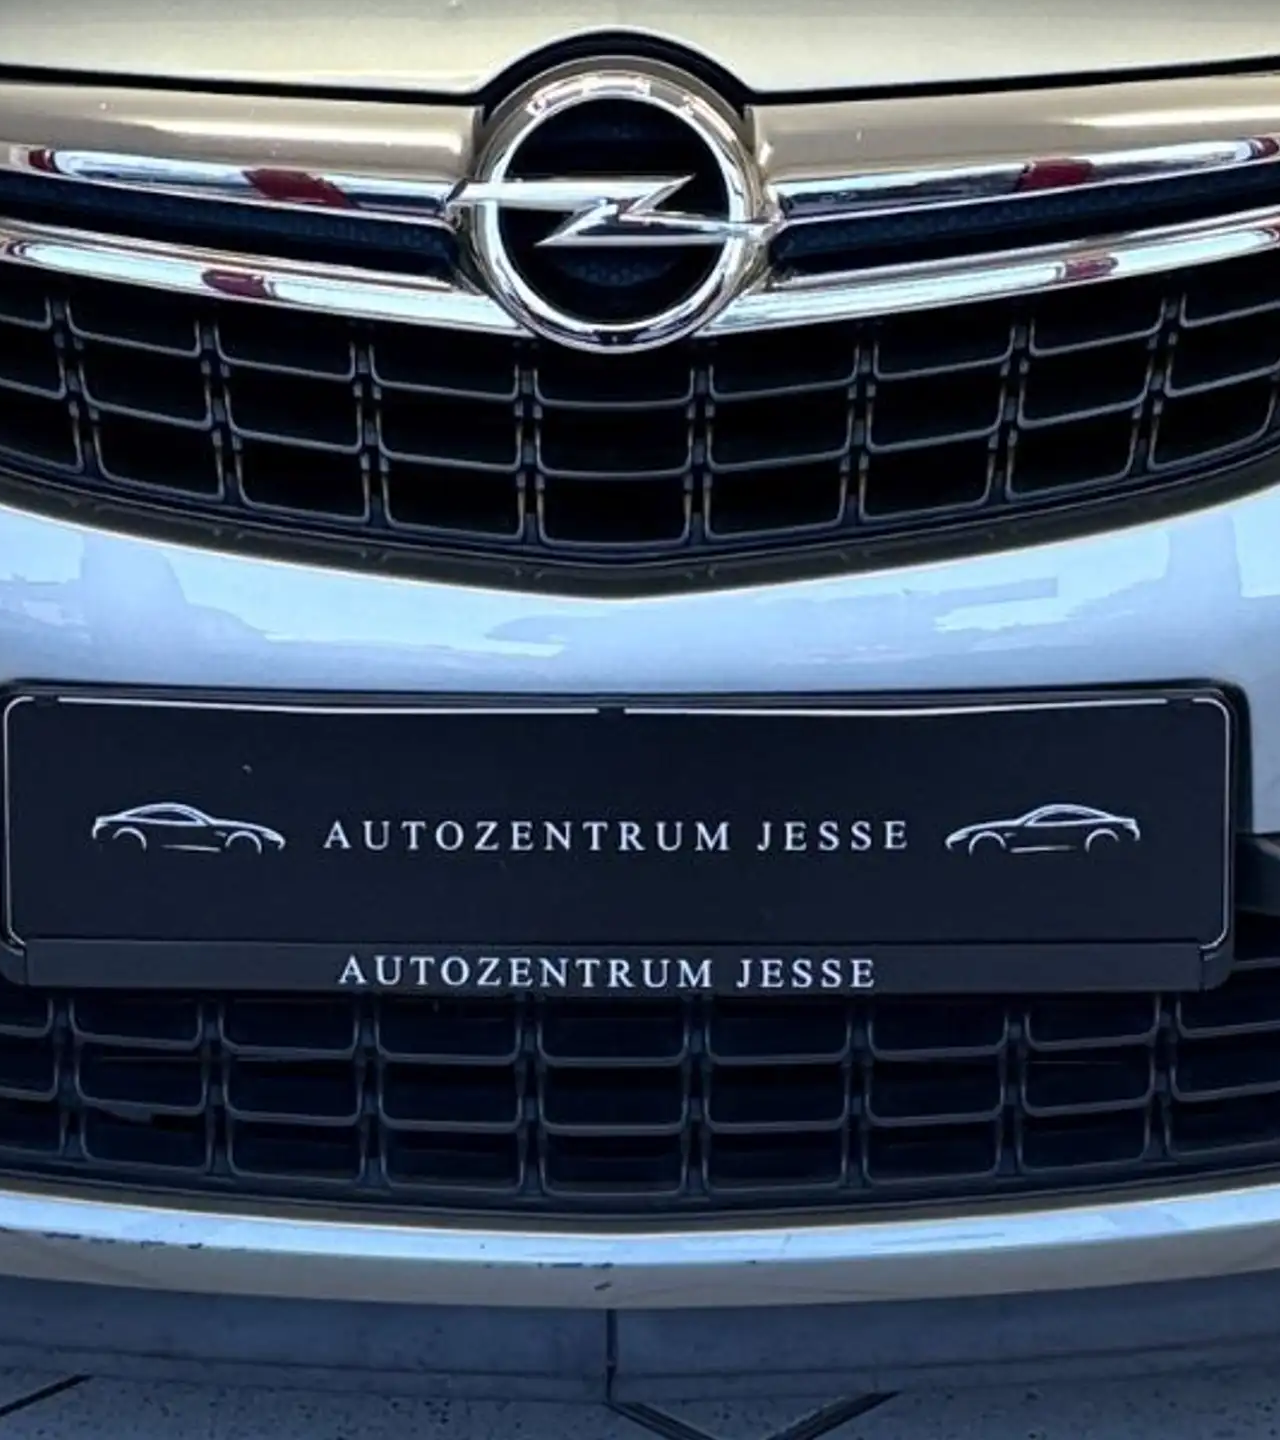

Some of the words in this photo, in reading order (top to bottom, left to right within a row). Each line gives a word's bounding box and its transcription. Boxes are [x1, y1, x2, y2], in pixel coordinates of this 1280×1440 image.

[323, 820, 730, 852] AUTOZENTRUM
[756, 820, 908, 852] JESSE
[338, 955, 713, 988] AUTOZENTRUM
[736, 957, 875, 989] JESSE
